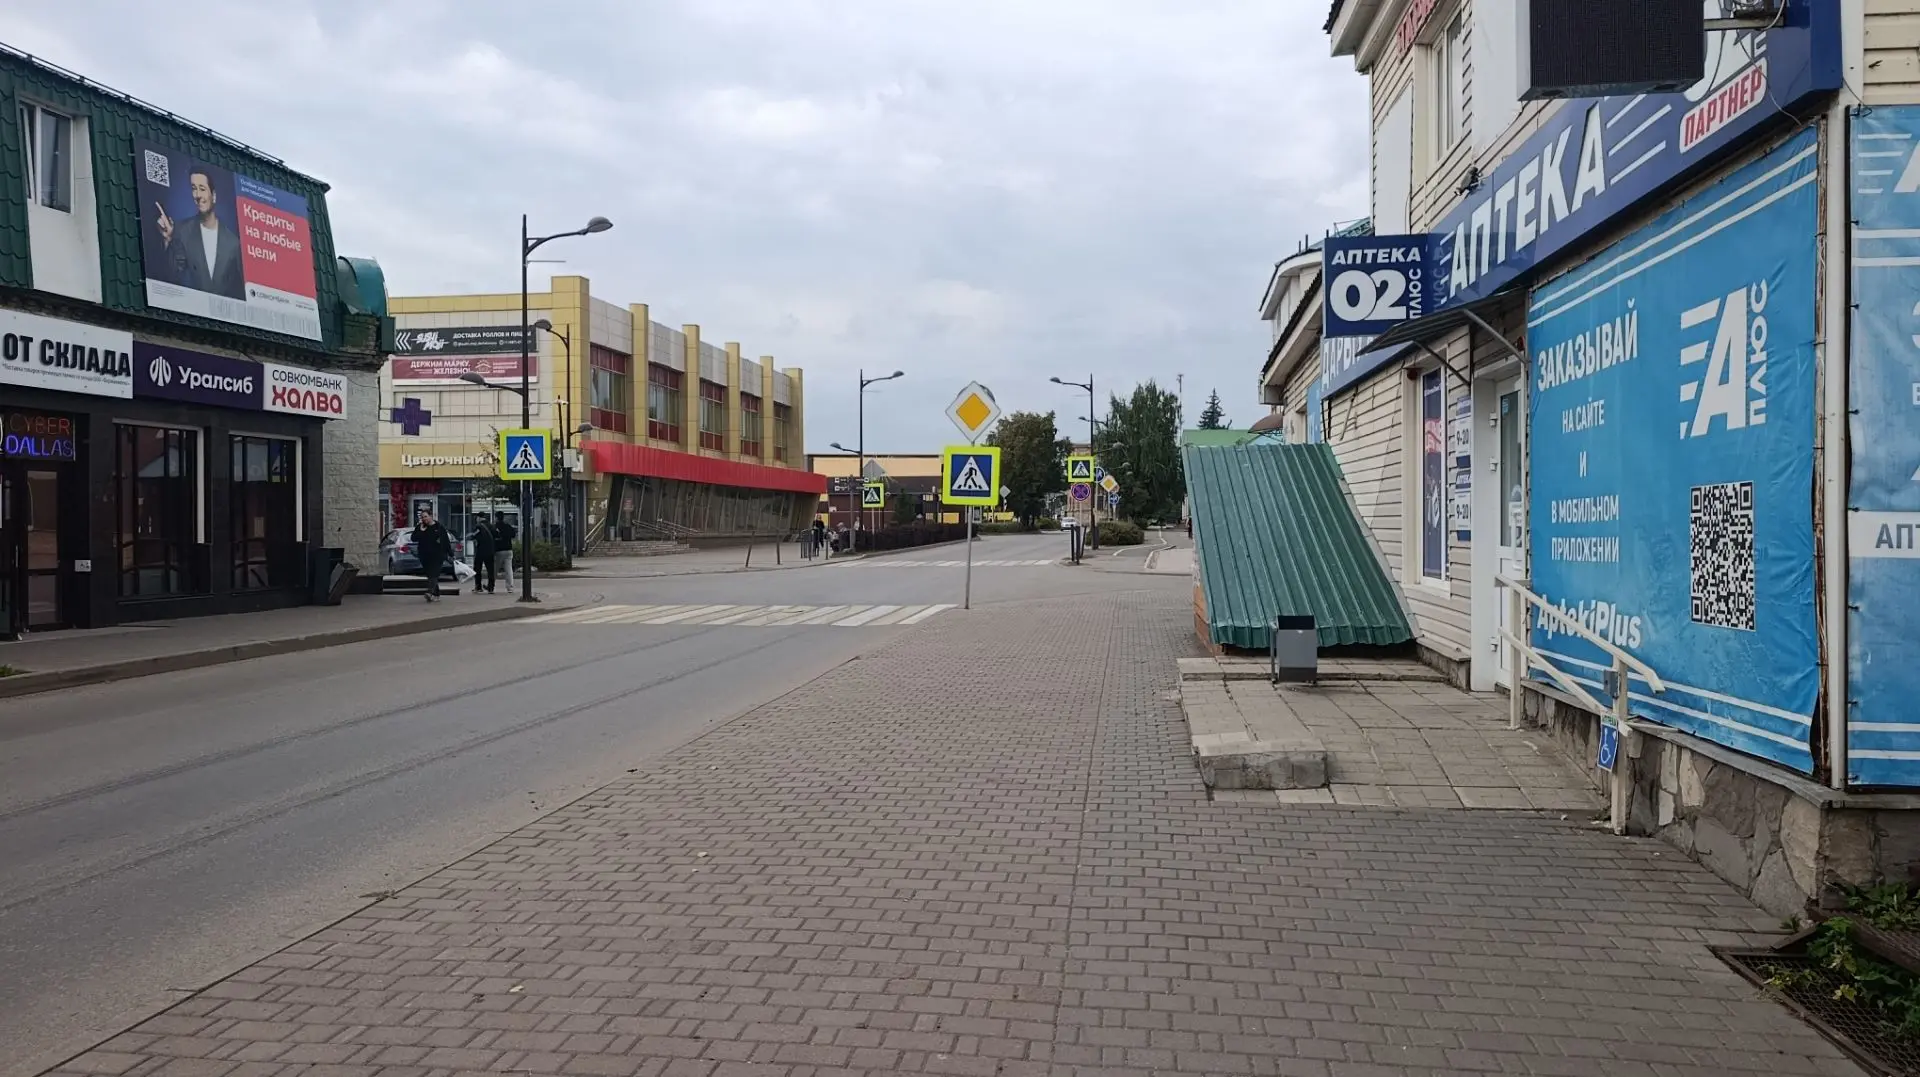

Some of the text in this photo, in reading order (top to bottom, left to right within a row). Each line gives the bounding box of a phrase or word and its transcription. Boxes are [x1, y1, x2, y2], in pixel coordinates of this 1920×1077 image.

[1684, 65, 1763, 147] ПАРТНЕР
[1449, 100, 1607, 298] АПТЕКА
[243, 203, 296, 232] Кредиты
[245, 225, 302, 252] на любые
[247, 244, 278, 262] цели
[1331, 247, 1421, 266] АПТЕКА
[1408, 267, 1422, 320] ПЛЮС
[3, 332, 34, 363] ОТ
[39, 338, 131, 378] СКЛАДА
[1537, 298, 1639, 392] ЗАКАЗЫВАЙ
[1749, 278, 1769, 427] ПЛЮС
[410, 360, 471, 369] ДЕРЖИМ МАРКУ.
[179, 364, 253, 395] Уралсиб
[272, 368, 342, 391] СОВКОМБАНК
[10, 412, 70, 435] CYBER
[1562, 398, 1605, 434] НА САЙТЕ
[6, 434, 74, 457] DALLAS
[401, 453, 485, 468] Цветочный
[1579, 451, 1587, 478] И
[1551, 501, 1557, 524] В
[1558, 494, 1619, 524] МОБИЛЬНОМ
[1551, 536, 1619, 563] ПРИЛОЖЕНИИ
